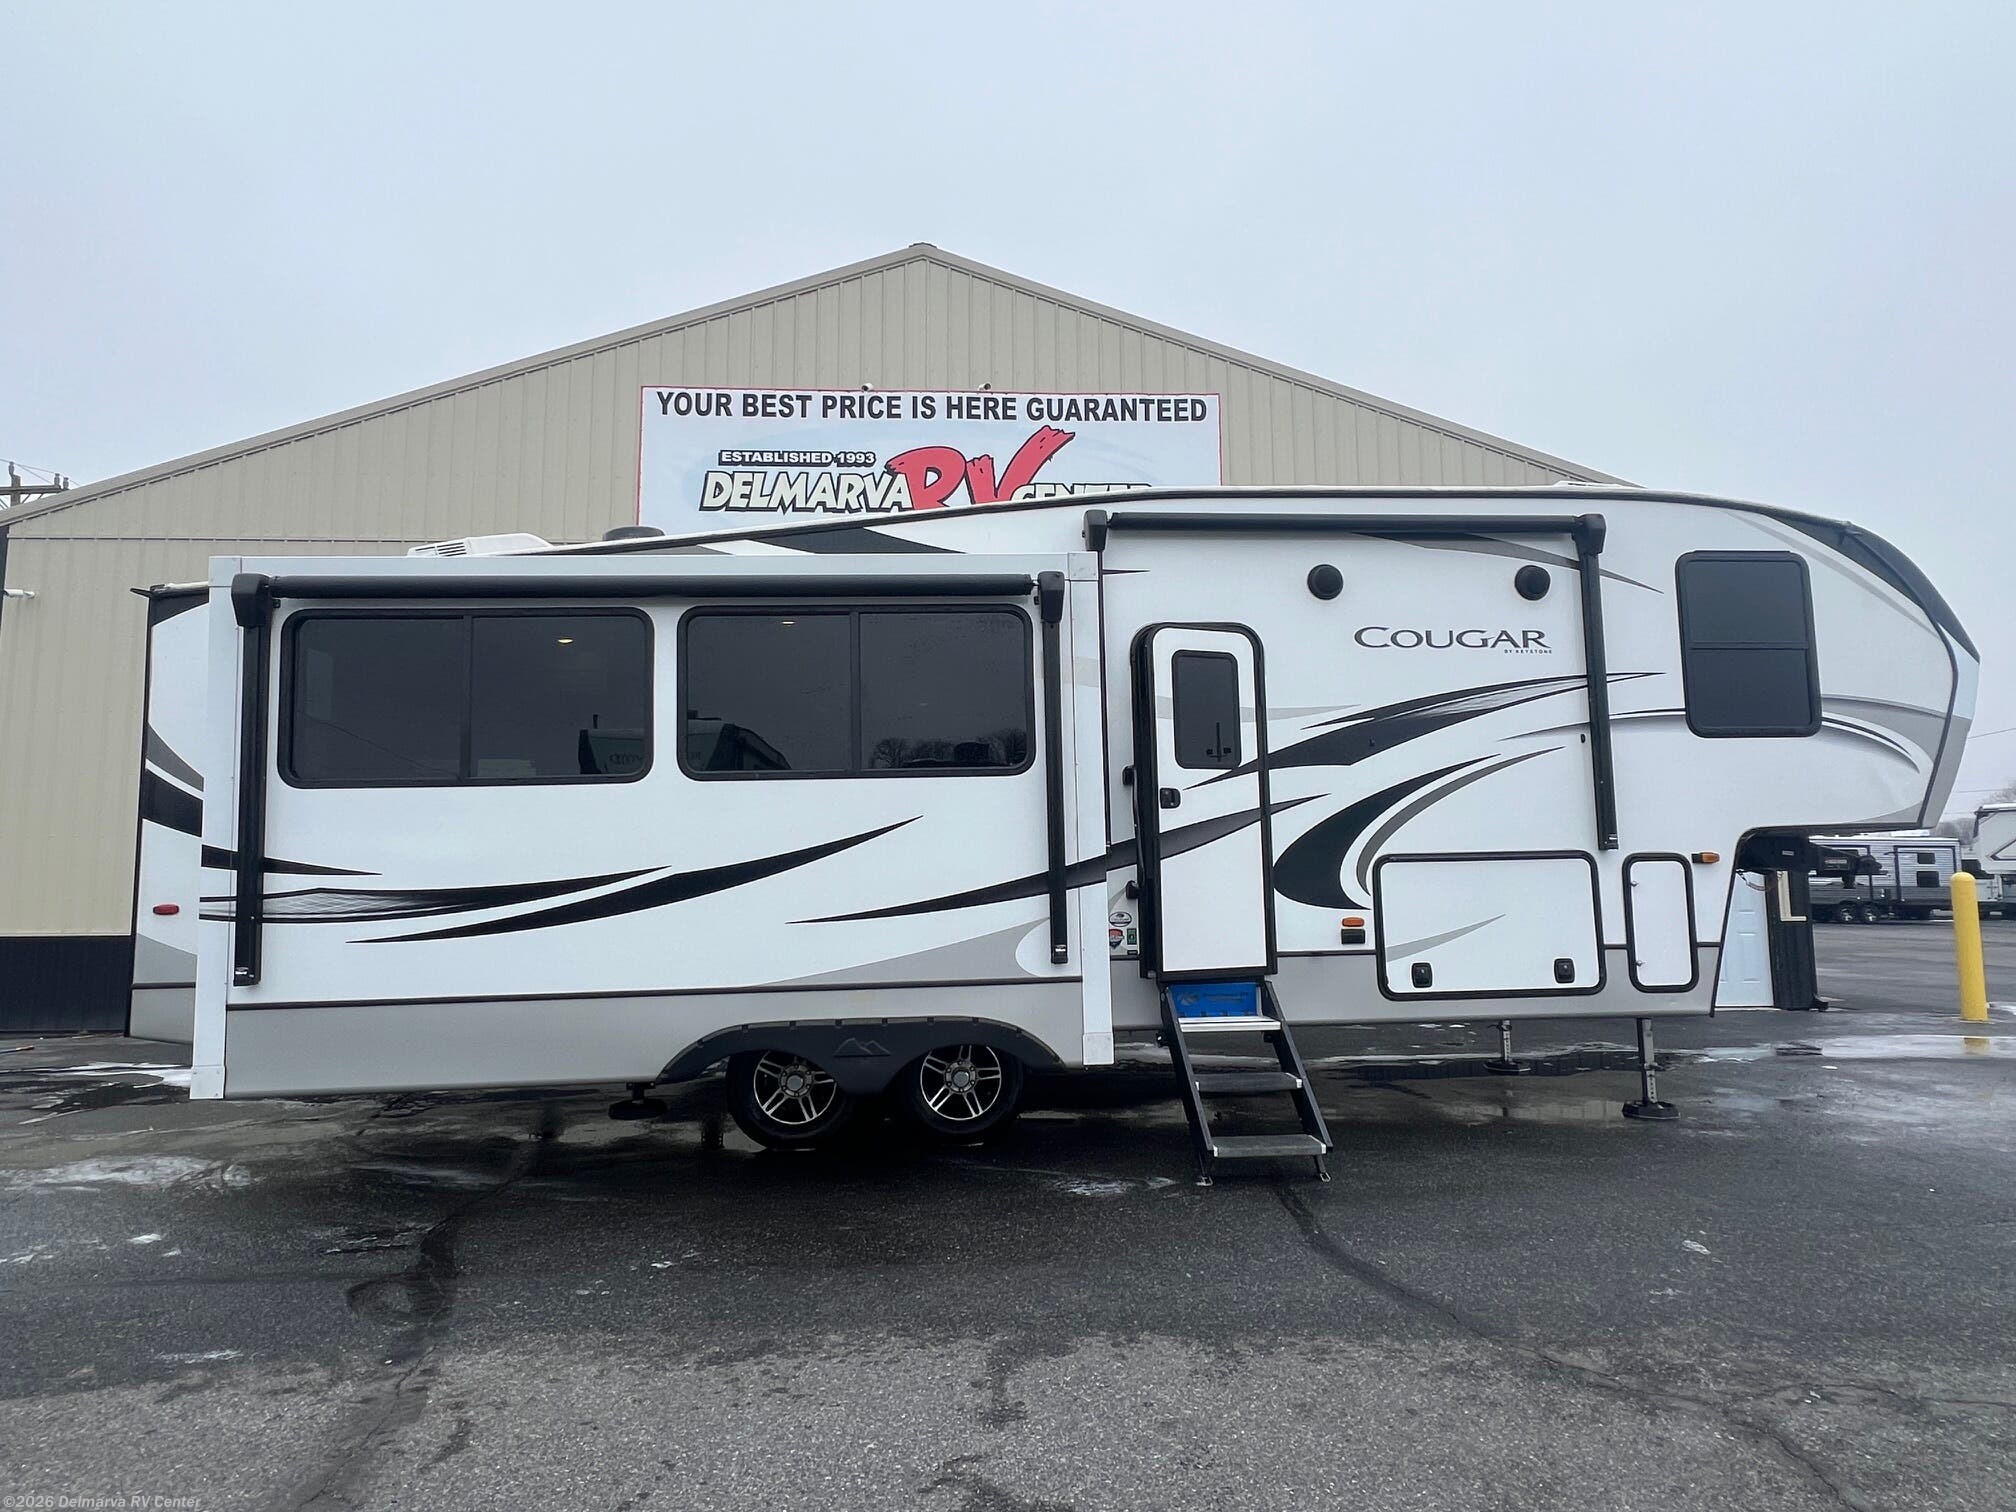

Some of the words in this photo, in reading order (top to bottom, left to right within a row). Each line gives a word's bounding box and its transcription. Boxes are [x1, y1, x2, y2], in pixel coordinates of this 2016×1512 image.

[657, 391, 732, 417] YOUR
[742, 393, 812, 418] BEST
[822, 396, 902, 419] PRICE
[912, 395, 936, 420] IS
[946, 396, 1017, 421] HERE
[1026, 398, 1207, 422] GUARANTEED
[699, 471, 912, 513] DELMARVA
[885, 424, 1076, 510] RV
[719, 451, 833, 464] ESTABLISHED
[836, 453, 877, 464] 1993
[1353, 626, 1551, 649] COUGAR
